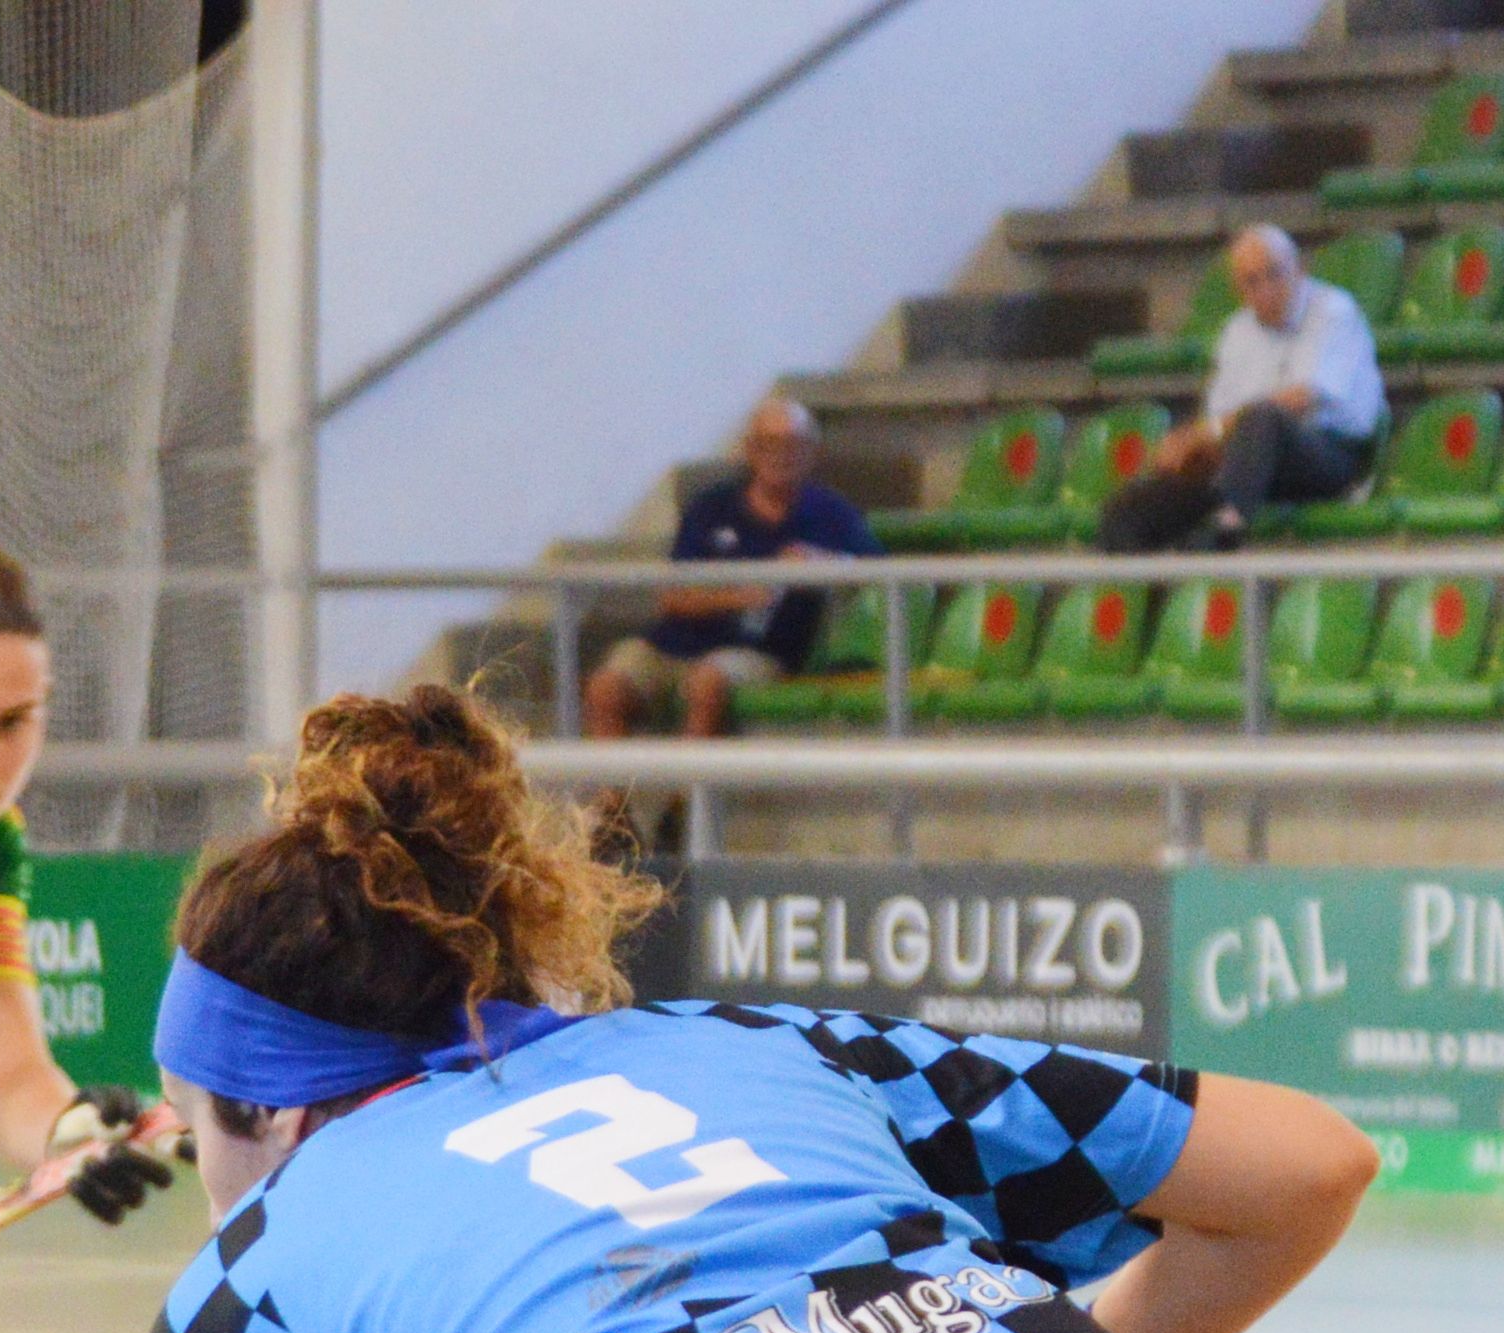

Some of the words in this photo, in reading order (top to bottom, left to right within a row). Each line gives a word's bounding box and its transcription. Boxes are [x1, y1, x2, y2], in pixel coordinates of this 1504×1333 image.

[705, 894, 1144, 988] MELGUIZO
[1192, 898, 1347, 1028] CAL
[443, 1073, 790, 1230] 2
